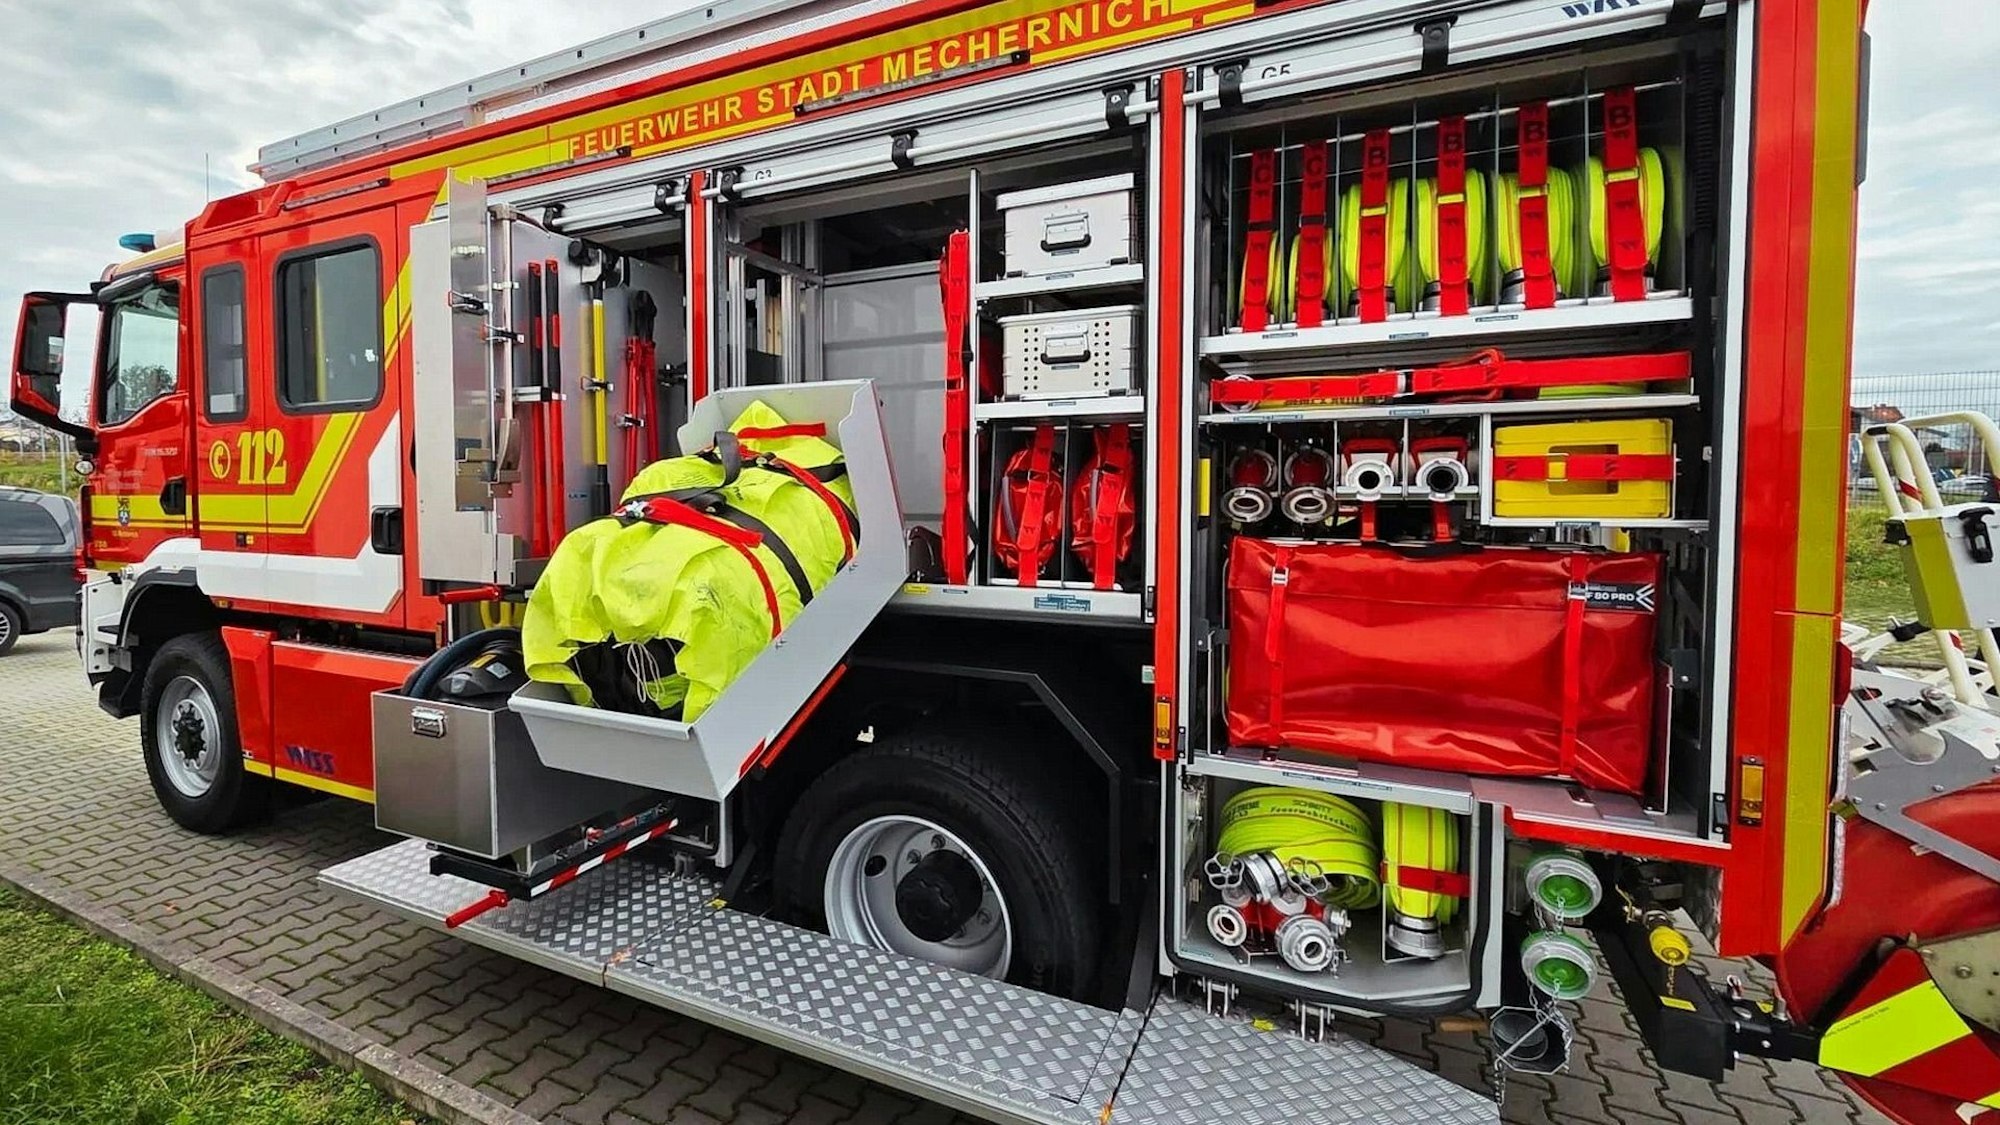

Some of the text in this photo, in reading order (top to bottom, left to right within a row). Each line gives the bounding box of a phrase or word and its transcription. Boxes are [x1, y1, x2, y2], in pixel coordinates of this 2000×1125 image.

[570, 0, 1169, 159] FEUERWEHR STADT MECHERNICH
[237, 428, 287, 485] 112
[1594, 591, 1610, 600] 80
[1610, 592, 1635, 602] PRO
